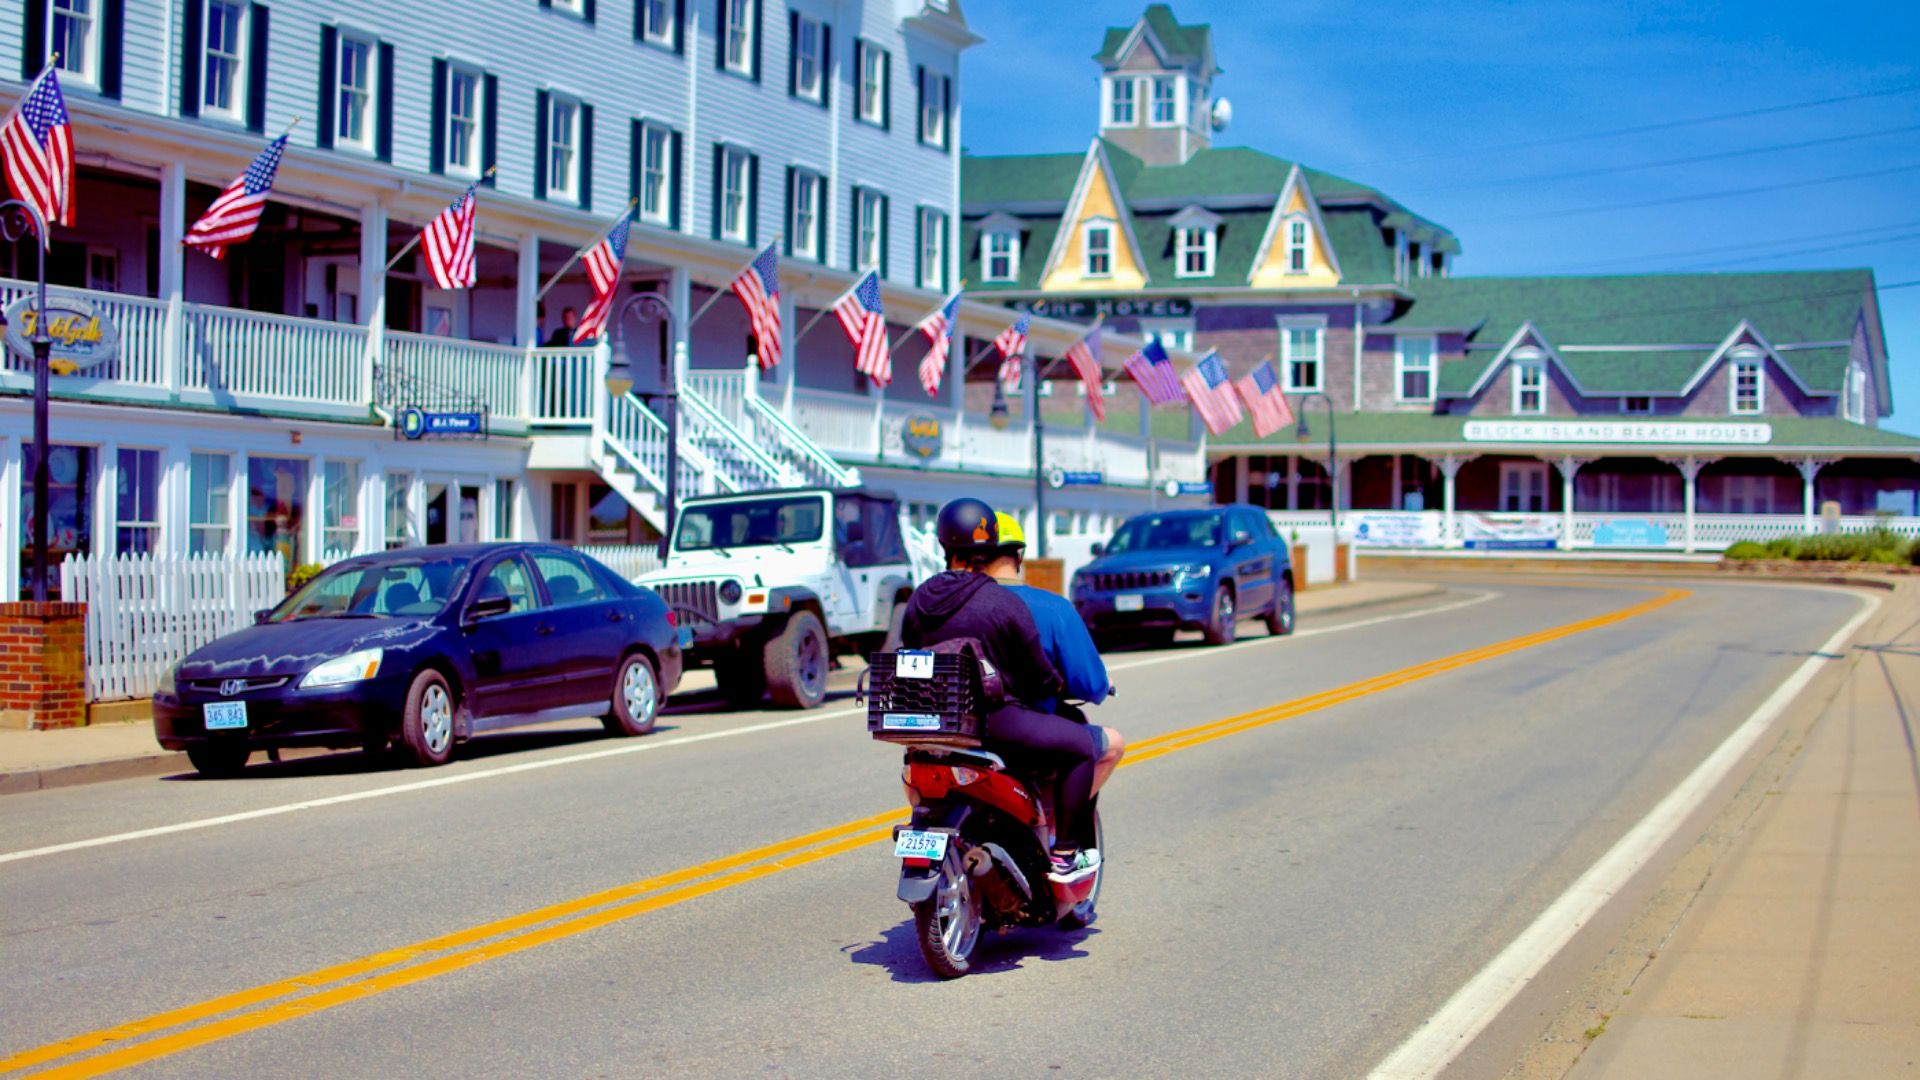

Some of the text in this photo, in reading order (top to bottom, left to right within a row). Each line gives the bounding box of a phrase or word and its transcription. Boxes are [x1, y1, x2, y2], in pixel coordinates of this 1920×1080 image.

[1097, 301, 1187, 316] HOTEL
[1471, 425, 1761, 438] BLOCK ISLAND BEACH HOUSE
[911, 657, 918, 671] 4
[905, 837, 937, 850] 21579
